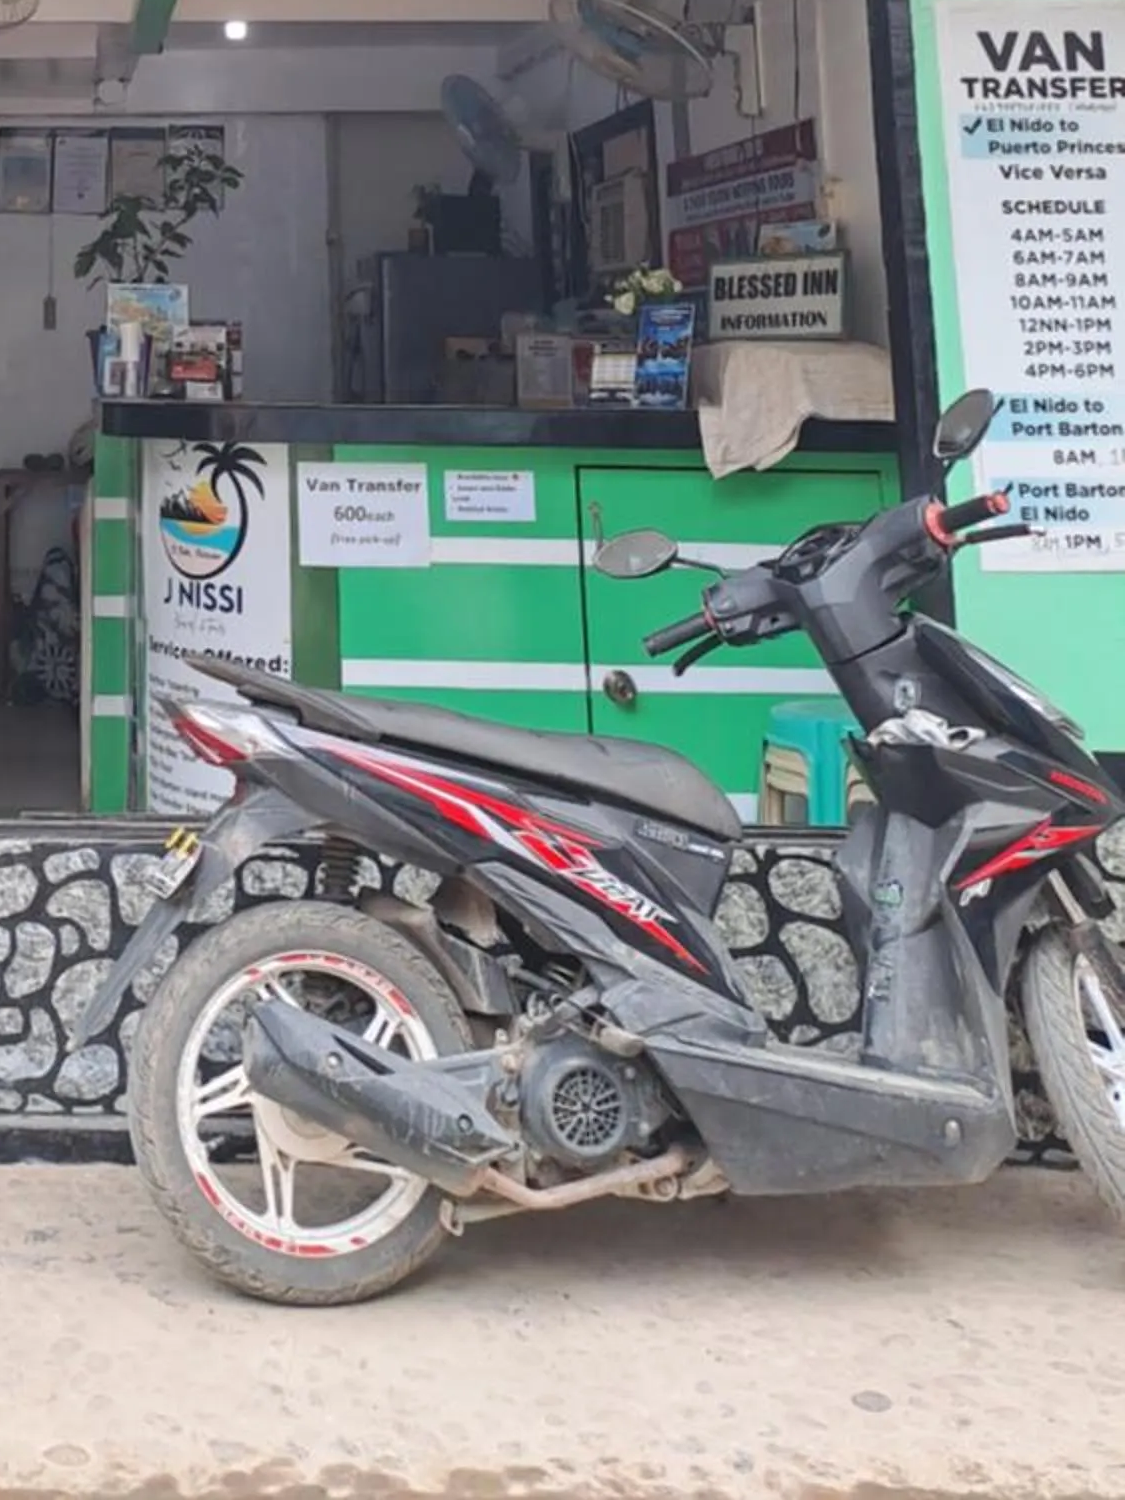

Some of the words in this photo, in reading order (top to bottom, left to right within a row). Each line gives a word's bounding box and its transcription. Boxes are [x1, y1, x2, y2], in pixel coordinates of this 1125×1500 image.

[976, 31, 1105, 72] VAN
[960, 76, 1125, 99] TRANSFER
[986, 118, 1004, 133] El
[1010, 117, 1054, 133] Nido
[1059, 119, 1080, 133] to
[987, 139, 1052, 154] Puerto
[999, 164, 1044, 180] Vice
[1049, 164, 1107, 180] Versa
[1001, 199, 1106, 215] SCHEDULE
[1010, 227, 1105, 243] 4AM-5AM
[1012, 250, 1106, 265] 6AM-7AM
[714, 272, 797, 301] BLESSED
[802, 268, 838, 296] INN
[1014, 272, 1109, 288] 8AM-9AM
[1010, 295, 1117, 310] 10AM-11AM
[720, 310, 827, 331] INFORMATION
[1019, 317, 1112, 333] 12NN-1PM
[1023, 340, 1112, 355] 2PM-3PM
[1024, 363, 1115, 378] 4PM-6PM
[1010, 398, 1028, 414] El
[1033, 398, 1078, 414] Nido
[1084, 399, 1105, 414] to
[1011, 421, 1053, 437] Port
[1058, 421, 1124, 437] Barton
[306, 478, 341, 493] Van
[346, 477, 422, 493] Transfer
[1018, 483, 1059, 498] Port
[1020, 505, 1038, 521] El
[1044, 505, 1090, 521] Nido
[163, 578, 173, 604] J
[178, 580, 243, 615] NISSI
